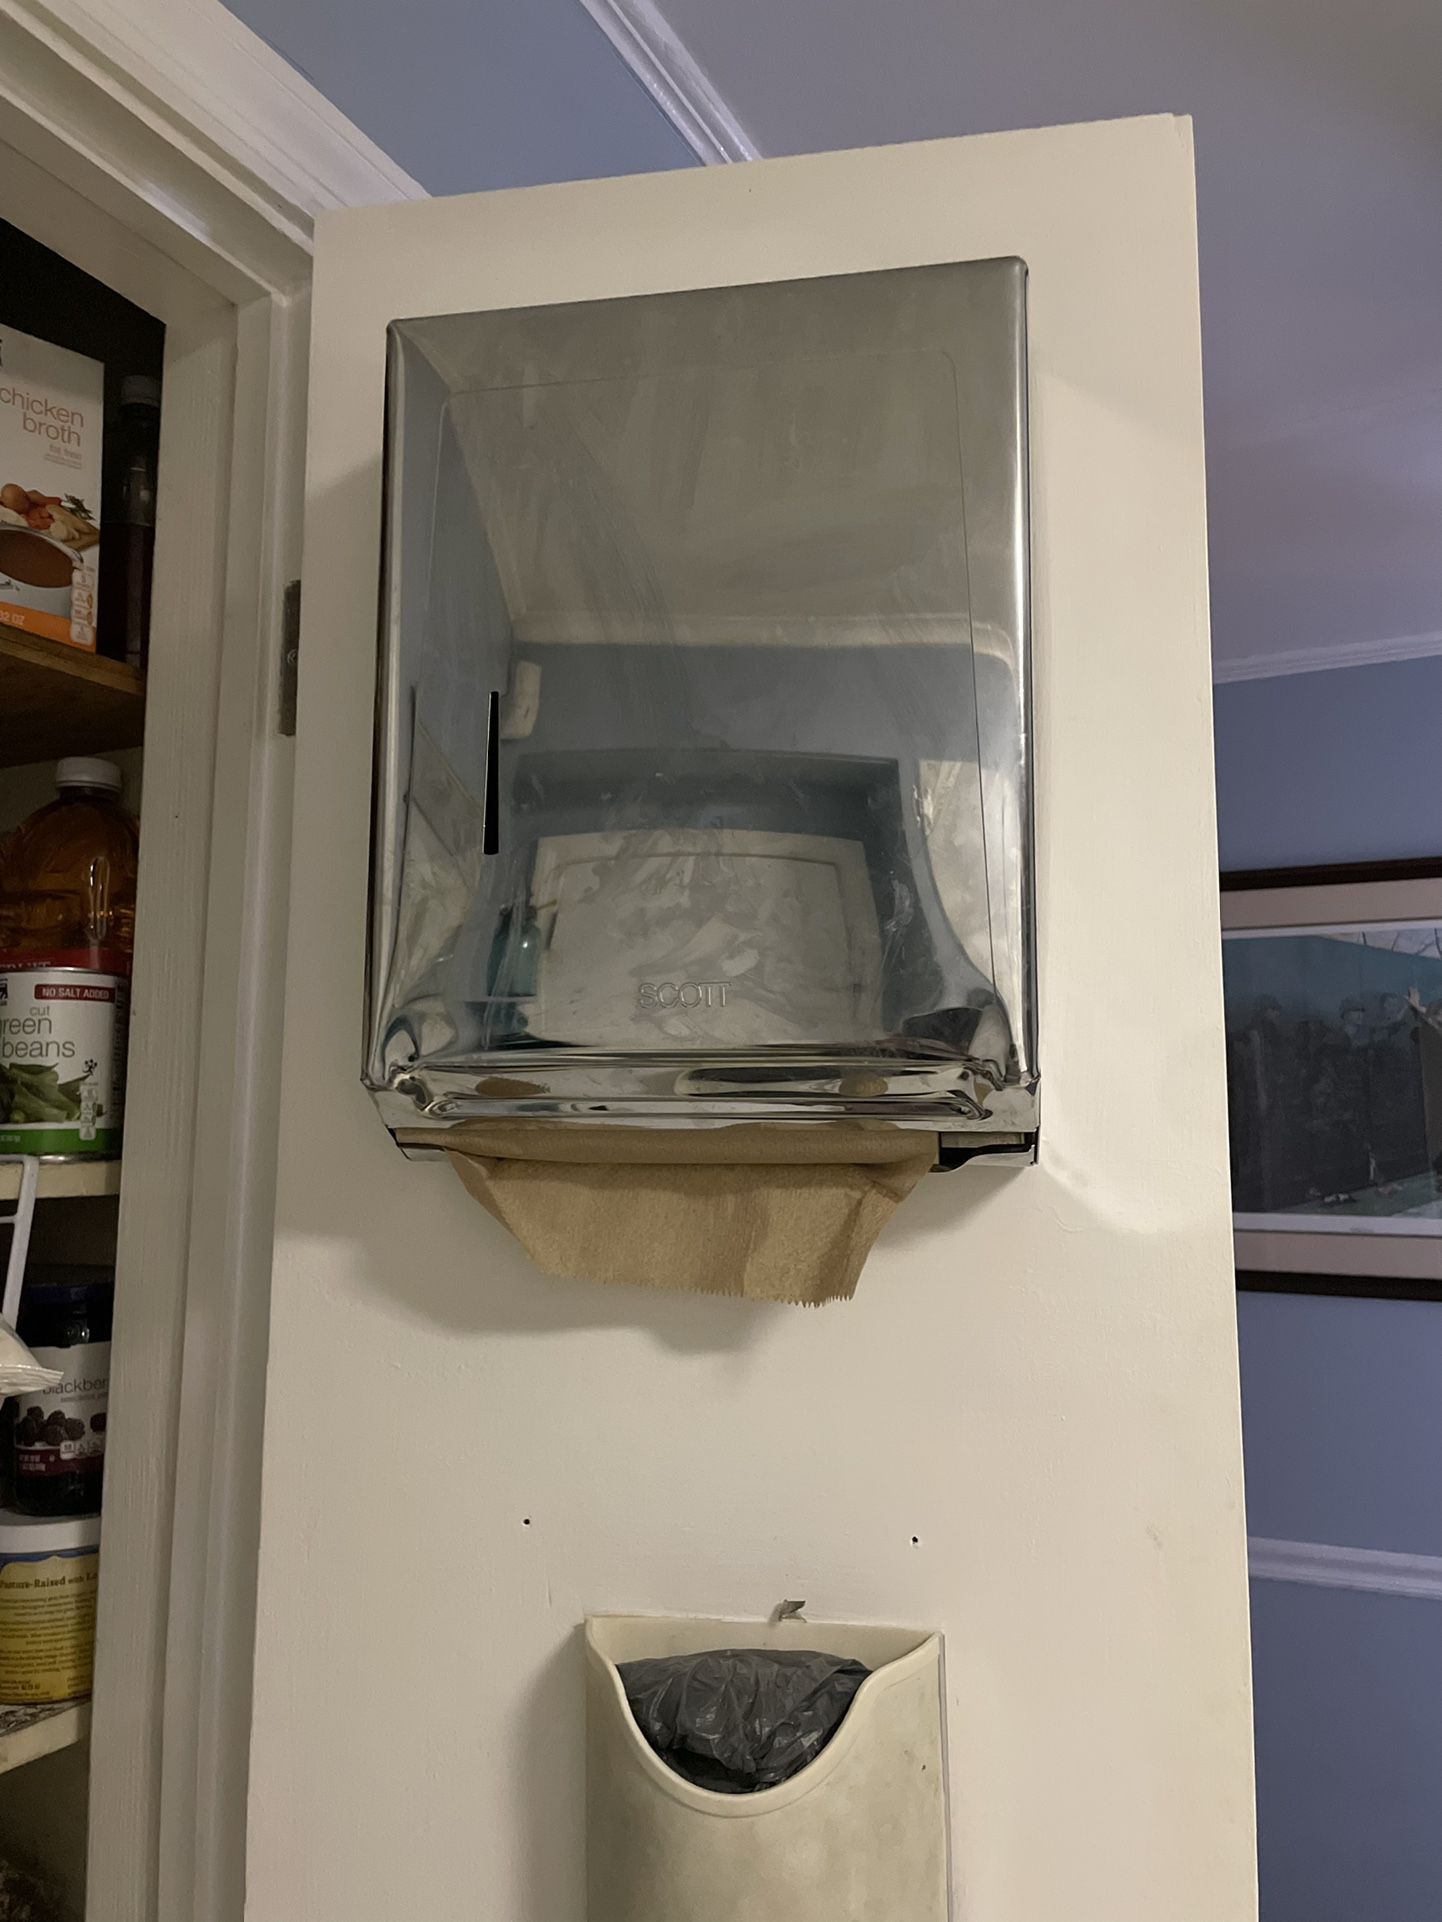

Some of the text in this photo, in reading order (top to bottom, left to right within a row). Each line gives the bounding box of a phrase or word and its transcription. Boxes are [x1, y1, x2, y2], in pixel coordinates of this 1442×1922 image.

[0, 387, 84, 428] chicken
[23, 412, 81, 447] broth
[42, 987, 110, 1001] NO SALT ADDED
[638, 980, 733, 1009] SCOTT
[29, 1005, 50, 1017] cut
[0, 1016, 52, 1037] reen
[2, 1036, 76, 1058] beans
